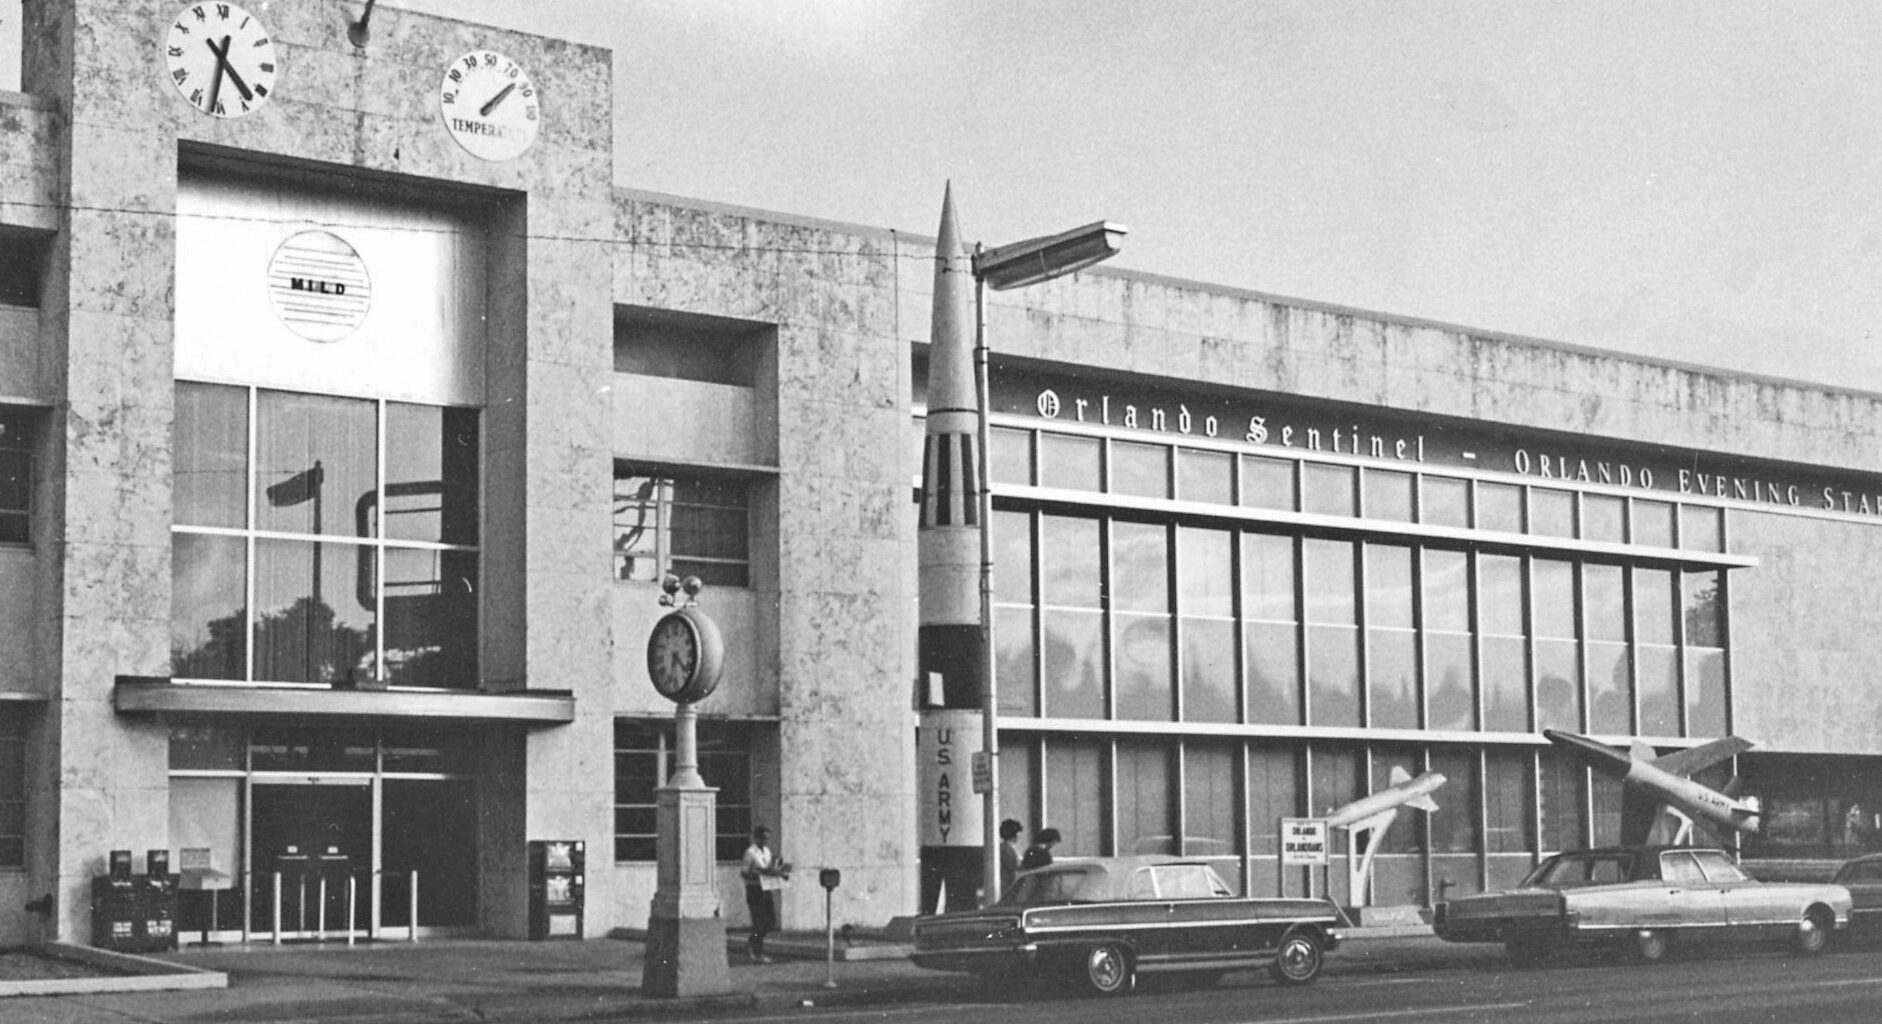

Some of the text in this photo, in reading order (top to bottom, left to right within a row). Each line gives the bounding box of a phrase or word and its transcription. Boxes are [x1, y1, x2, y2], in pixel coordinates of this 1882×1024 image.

[463, 55, 477, 69] 30
[484, 53, 497, 66] 50
[448, 69, 461, 82] 10
[504, 62, 518, 78] 70
[291, 277, 345, 295] MILD
[1037, 389, 1217, 437] Orlando
[1246, 416, 1424, 462] Sentinel
[1514, 449, 1653, 489] ORLANDO
[1678, 468, 1800, 506] EVENING
[937, 772, 952, 843] ARMY
